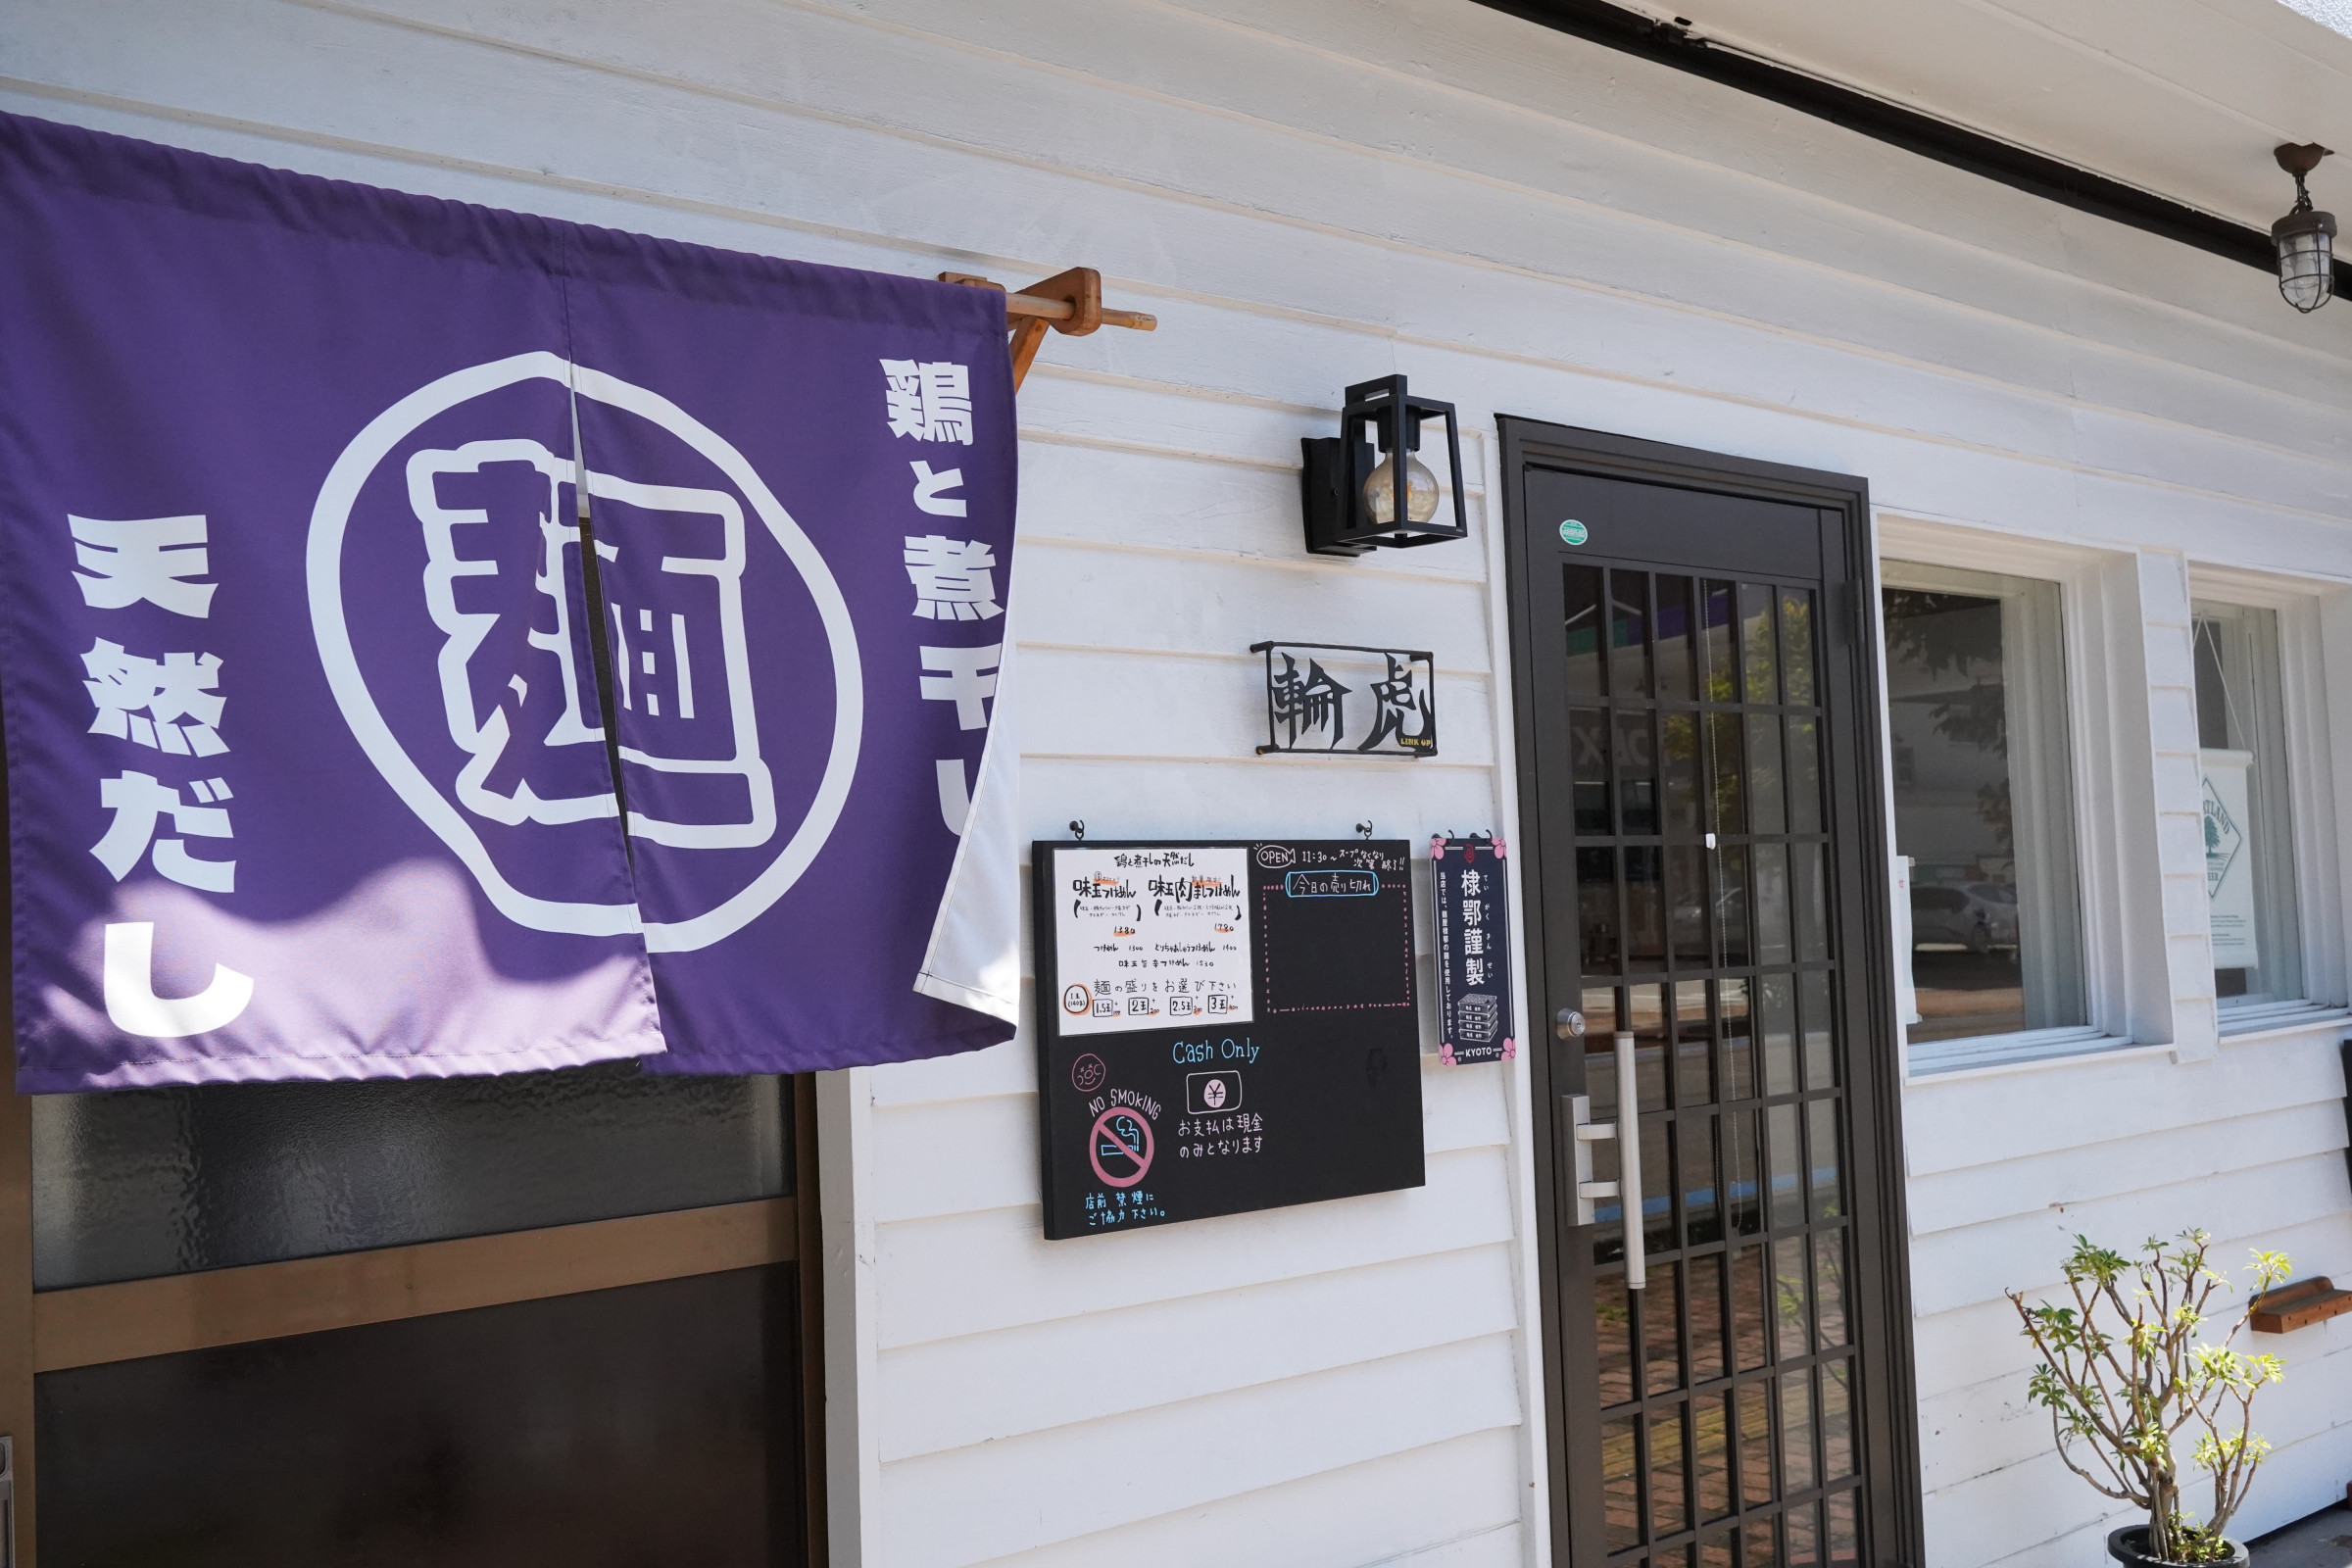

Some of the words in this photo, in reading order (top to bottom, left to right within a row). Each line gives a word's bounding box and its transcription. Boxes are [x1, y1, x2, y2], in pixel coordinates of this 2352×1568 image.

[67, 514, 254, 1038] 天然だし
[1113, 851, 1195, 868] 鶏と煮干しの天然だし
[1260, 851, 1290, 864] OPEN
[1293, 872, 1371, 896] 今日の売り切れ
[2207, 871, 2219, 882] EER
[1072, 876, 1137, 899] 味玉つけめん
[1114, 926, 1136, 935] 1380
[1214, 923, 1234, 933] 1780
[1093, 943, 1119, 952] つけめん
[1094, 978, 1237, 997] 麺の盛りをお選び下さい
[1172, 1040, 1213, 1064] Cash
[1221, 1037, 1260, 1064] Only
[1465, 1047, 1493, 1057] KYOTO
[1089, 1097, 1105, 1117] NO
[1110, 1089, 1161, 1120] SMOKING
[1178, 1112, 1263, 1137] お支払は現金
[1179, 1136, 1263, 1158] のみとなります
